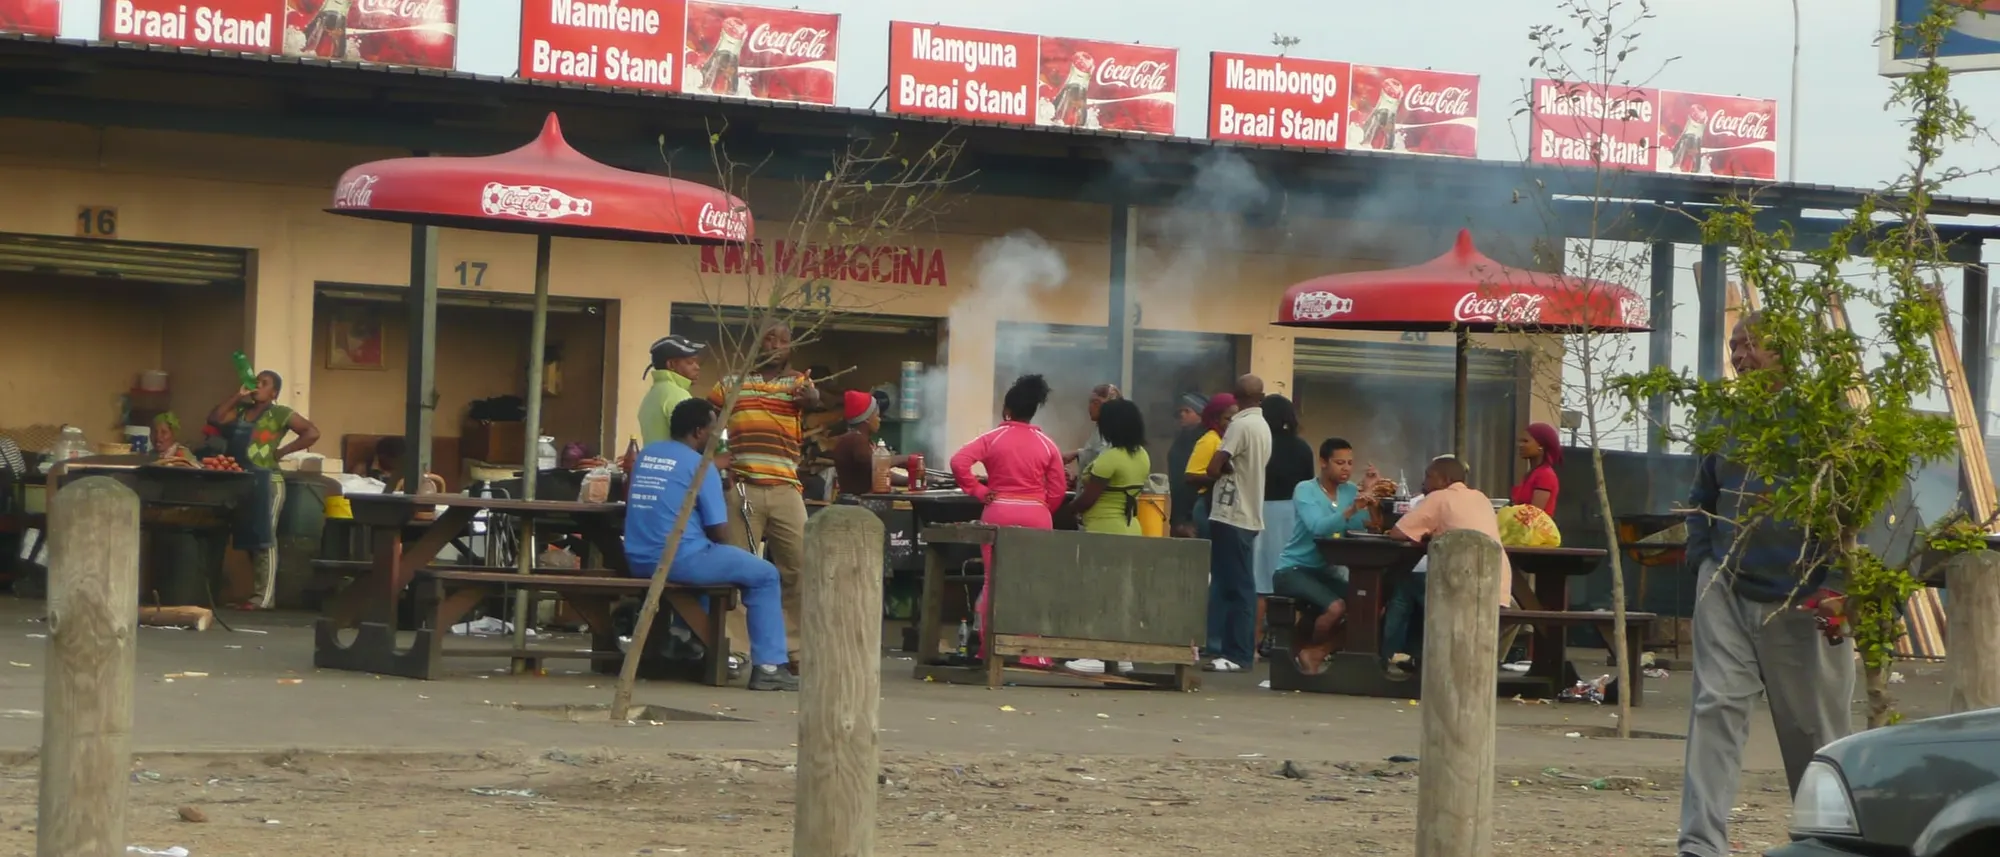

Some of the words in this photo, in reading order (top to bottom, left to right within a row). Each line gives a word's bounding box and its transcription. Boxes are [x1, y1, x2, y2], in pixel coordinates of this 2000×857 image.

[115, 0, 186, 41] Braai
[194, 6, 272, 48] Stand
[551, 0, 659, 35] Mamfene
[748, 22, 830, 59] Coca-Cola
[912, 27, 1017, 73] Mamguna
[533, 39, 598, 78] Braai
[604, 46, 672, 85] Stand
[1096, 56, 1170, 91] Coca-Cola
[900, 74, 958, 110] Braai
[964, 80, 1026, 116] Stand
[1226, 58, 1337, 104] Mambongo
[1405, 83, 1472, 116] Coca-Cola
[1219, 104, 1275, 137] Braai
[1280, 108, 1338, 142] Stand
[1709, 109, 1771, 140] Coca-Cola
[1541, 129, 1592, 161] Braai
[1596, 133, 1649, 166] Stand
[79, 208, 116, 235] 16
[455, 260, 487, 286] 17
[800, 280, 831, 307] 18
[1454, 291, 1545, 322] Coca-Cola
